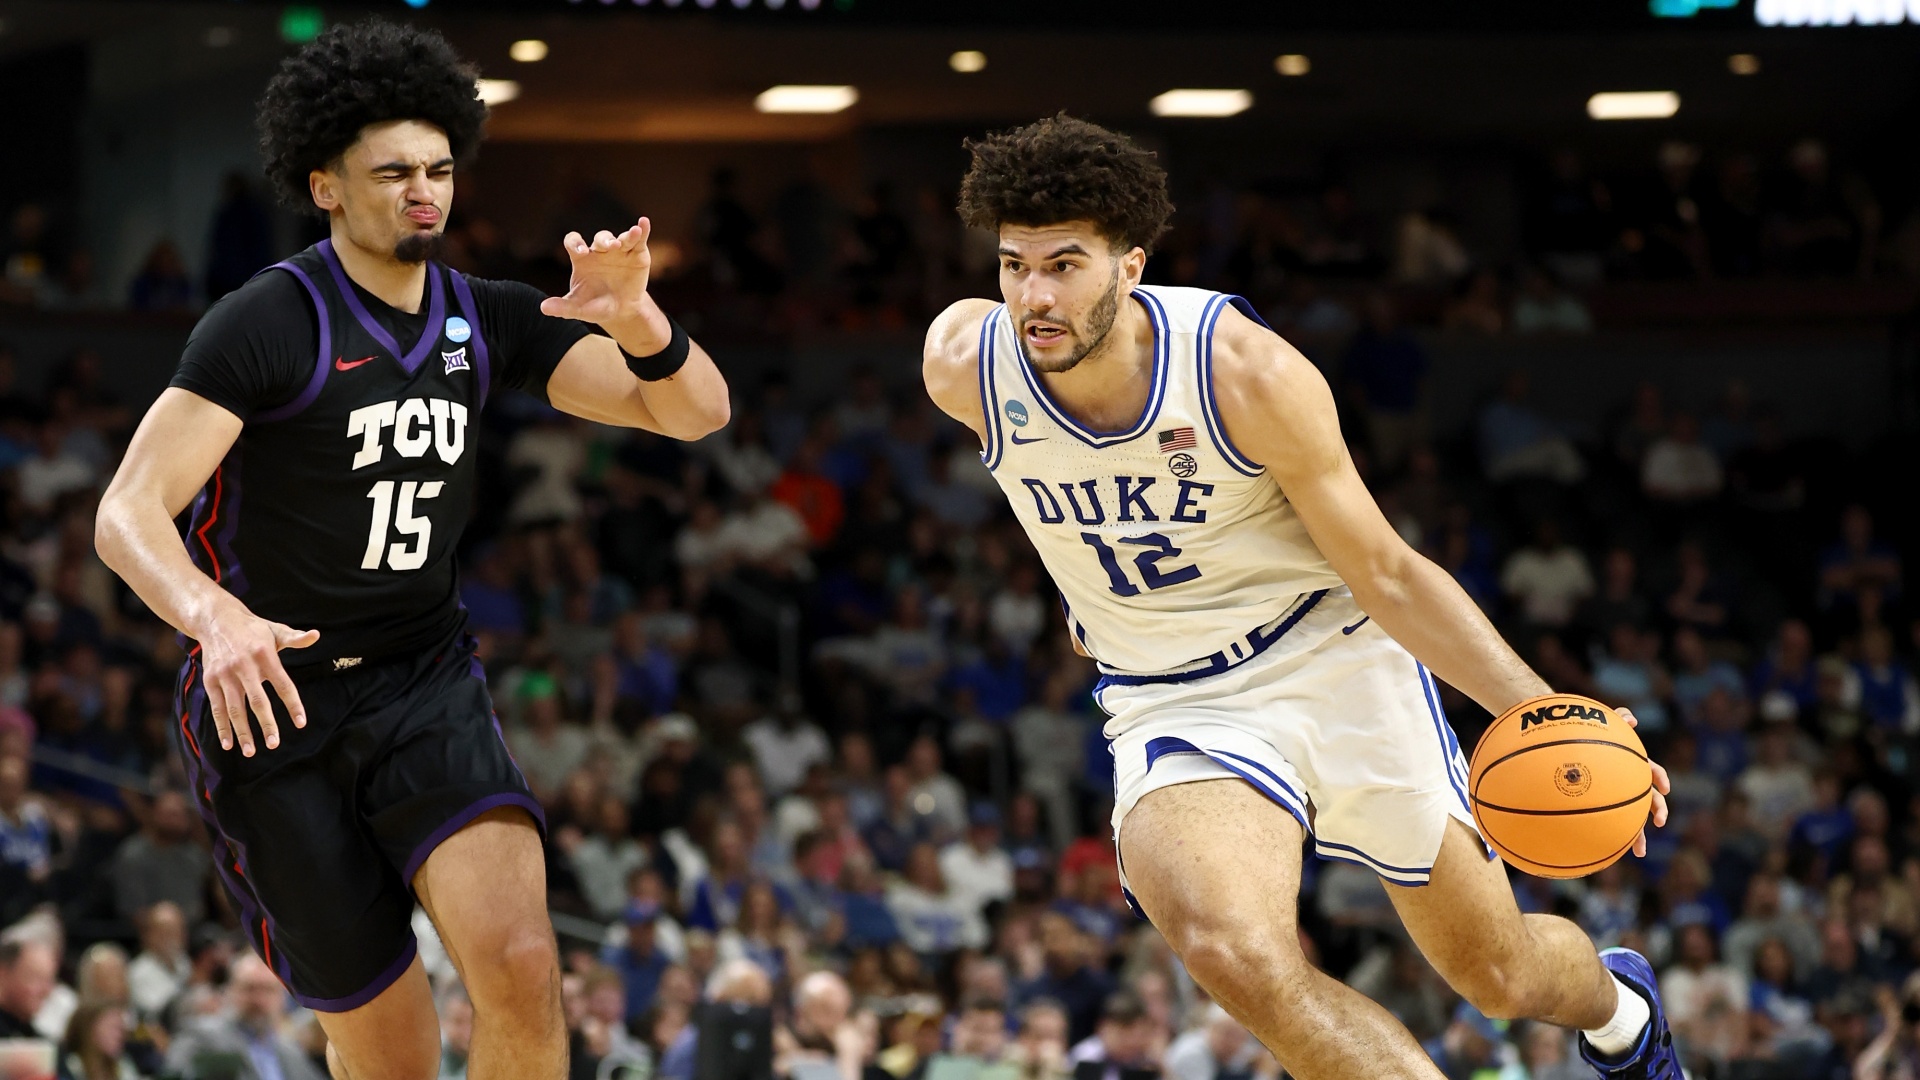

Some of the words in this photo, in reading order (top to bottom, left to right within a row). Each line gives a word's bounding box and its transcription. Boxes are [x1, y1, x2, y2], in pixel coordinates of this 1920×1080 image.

[448, 326, 471, 337] NCAA
[347, 398, 468, 470] TCU
[1008, 410, 1027, 424] NCAA
[1021, 476, 1215, 525] DUKE
[360, 480, 447, 571] 15
[1080, 532, 1203, 597] 12
[1521, 704, 1608, 731] NCAA
[1521, 723, 1558, 737] OFFICIAL
[1587, 723, 1608, 731] BALL
